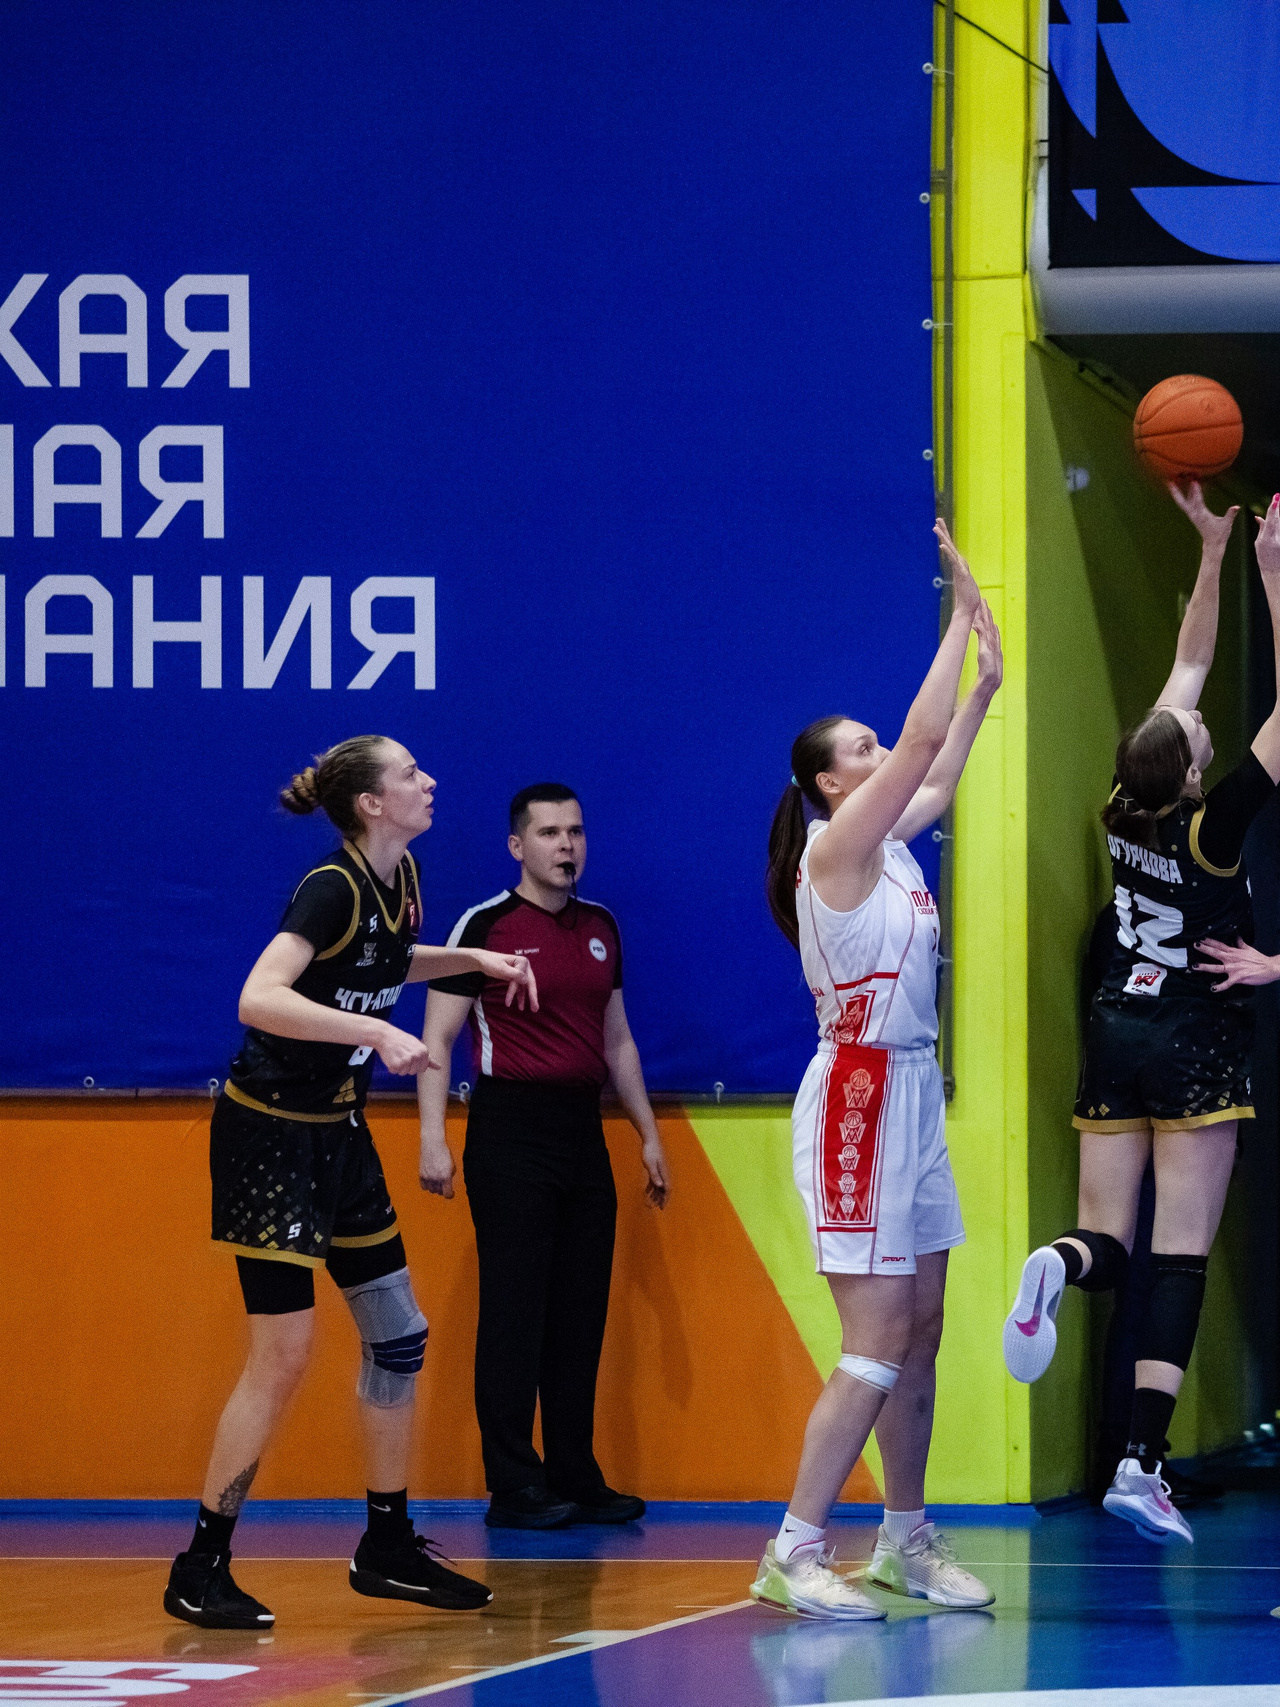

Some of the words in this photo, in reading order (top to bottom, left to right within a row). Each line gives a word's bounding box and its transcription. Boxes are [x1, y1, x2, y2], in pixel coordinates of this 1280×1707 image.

[0, 424, 225, 538] АЯ
[0, 574, 436, 690] АНИЯ
[1114, 885, 1188, 968] 12
